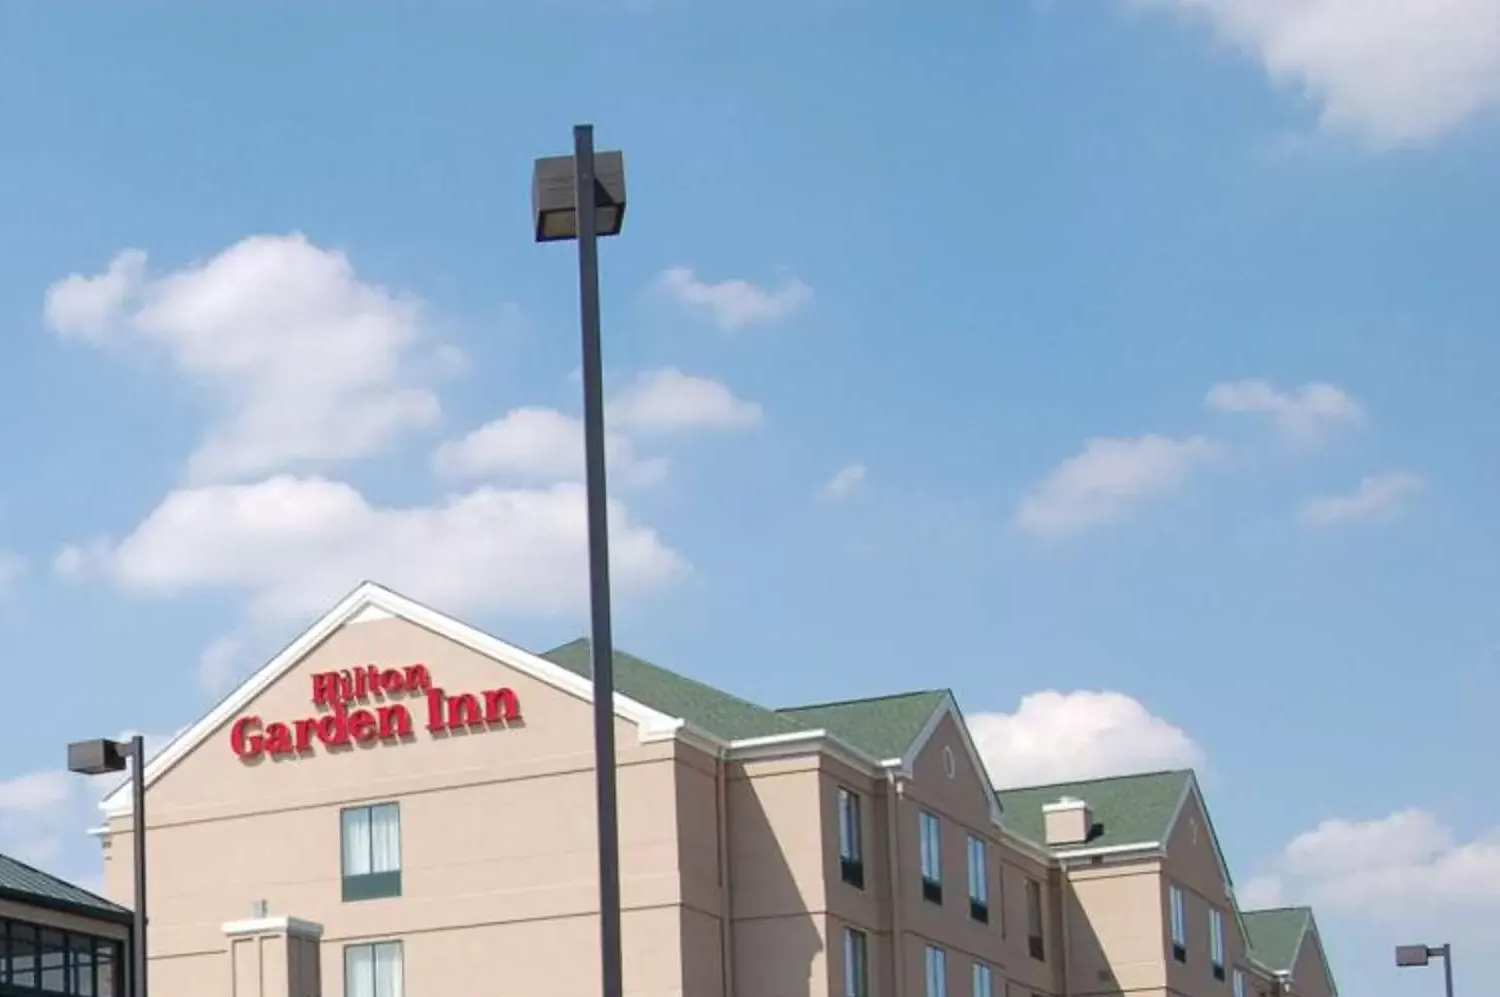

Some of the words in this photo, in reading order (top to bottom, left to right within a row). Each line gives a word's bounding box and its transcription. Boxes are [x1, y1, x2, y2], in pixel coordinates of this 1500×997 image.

[311, 663, 432, 707] Hilton
[230, 700, 414, 760] Garden
[426, 685, 523, 733] Inn
